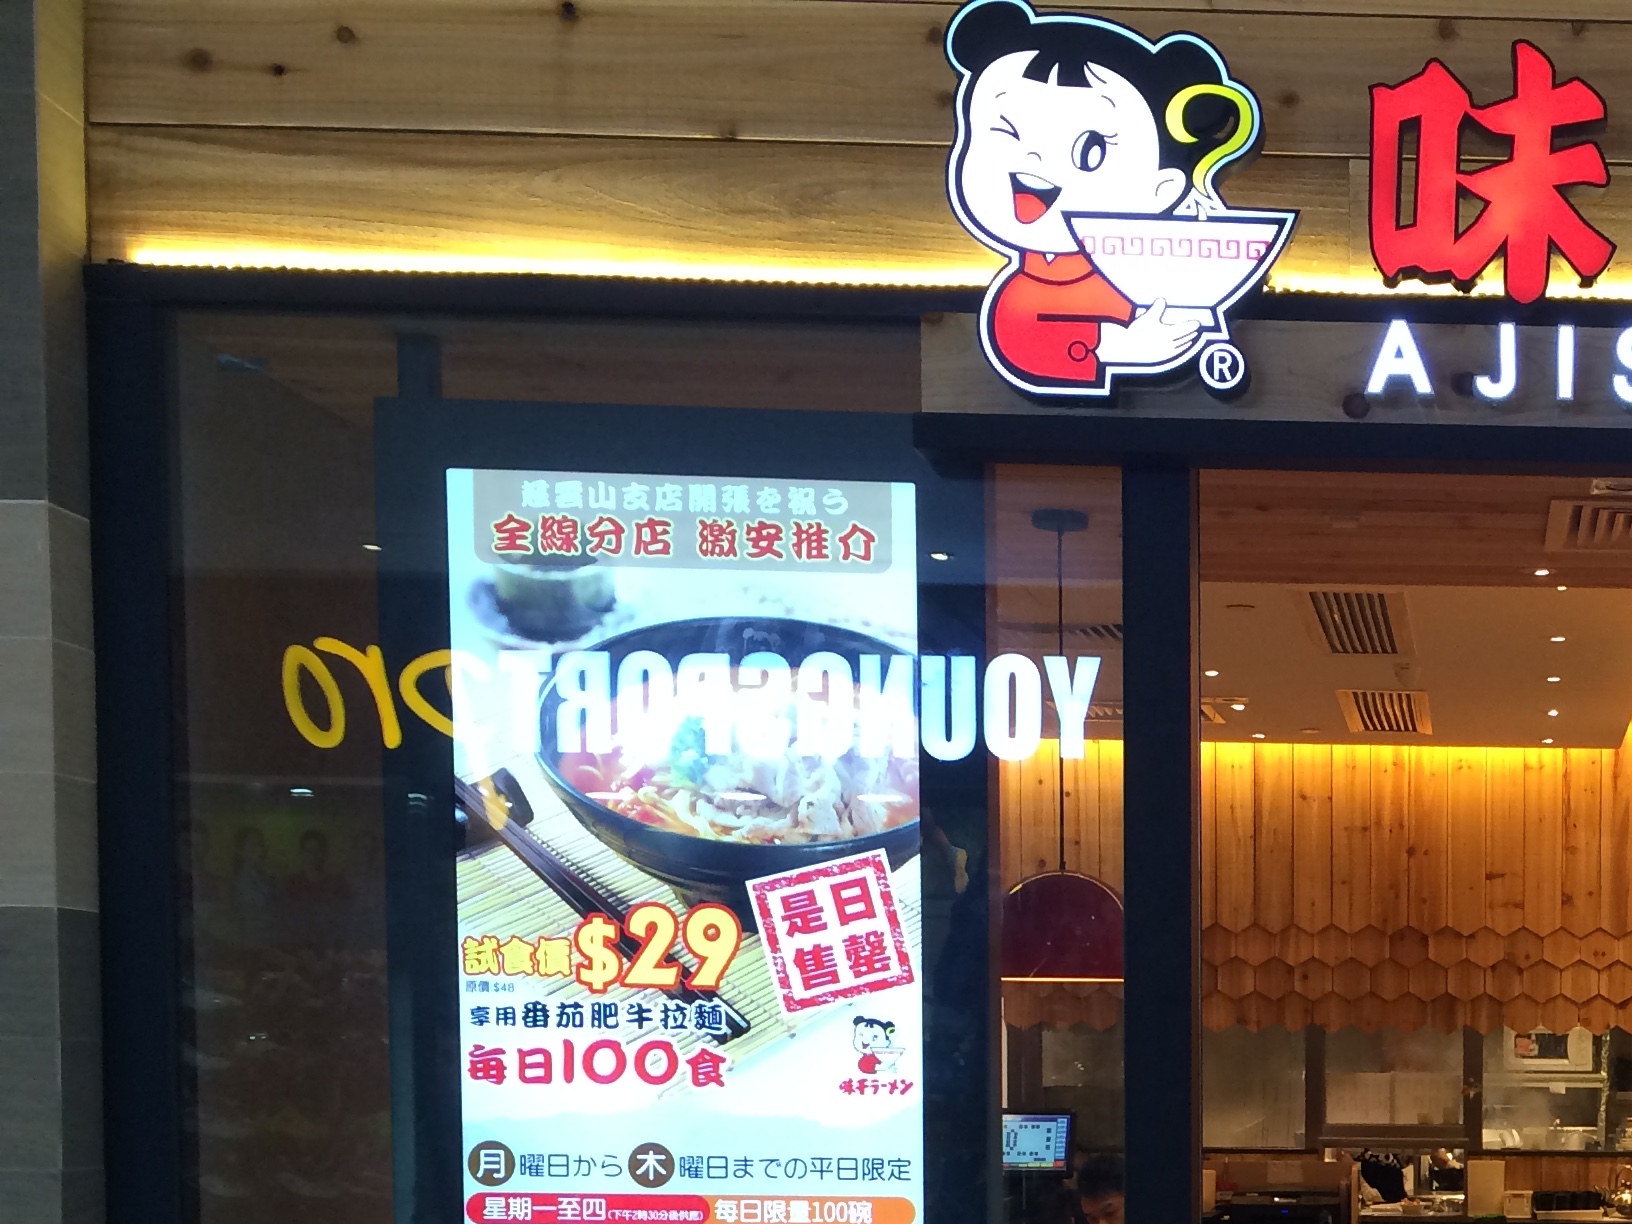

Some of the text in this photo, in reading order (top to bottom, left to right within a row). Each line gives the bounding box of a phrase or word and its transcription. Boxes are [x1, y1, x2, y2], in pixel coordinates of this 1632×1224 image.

[491, 513, 878, 563] 全線分店 激安推介
[780, 876, 877, 938] 是日
[575, 901, 743, 995] $29
